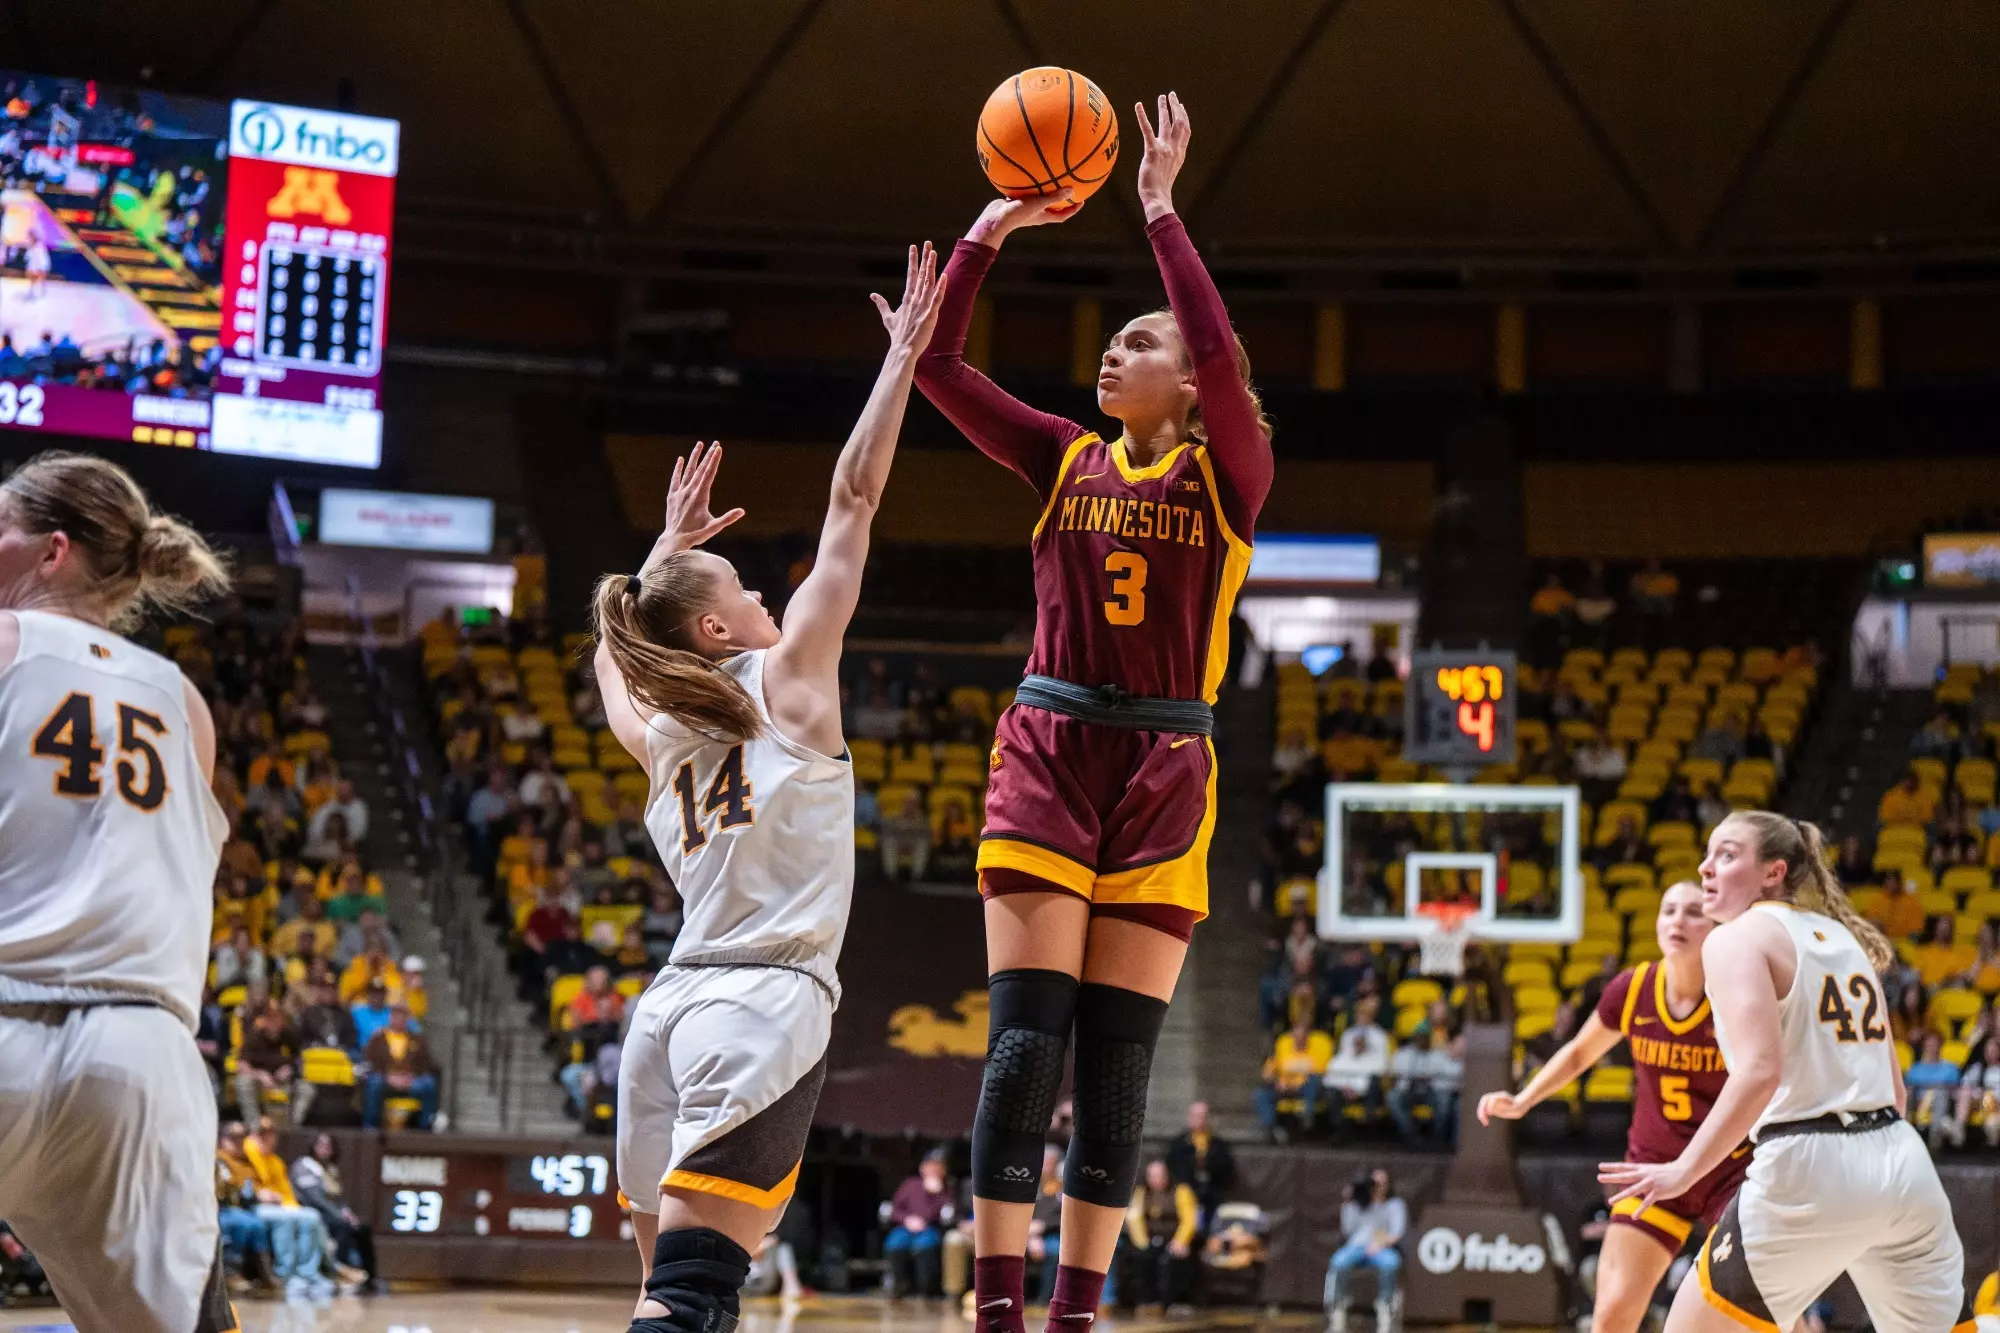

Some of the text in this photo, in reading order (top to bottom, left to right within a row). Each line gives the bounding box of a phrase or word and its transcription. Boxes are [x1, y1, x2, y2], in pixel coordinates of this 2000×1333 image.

[295, 120, 387, 165] fnbo
[0, 381, 45, 427] 32
[1058, 496, 1205, 547] MINNESOTA
[1104, 551, 1148, 626] 3
[1457, 701, 1494, 752] 4
[30, 689, 172, 815] 45
[672, 741, 755, 857] 14
[1818, 972, 1886, 1044] 42
[1631, 1034, 1727, 1073] MINNESOTA
[1659, 1075, 1693, 1121] 5
[391, 1190, 443, 1233] 33
[568, 1204, 593, 1238] 3
[1463, 1232, 1546, 1274] fnbo
